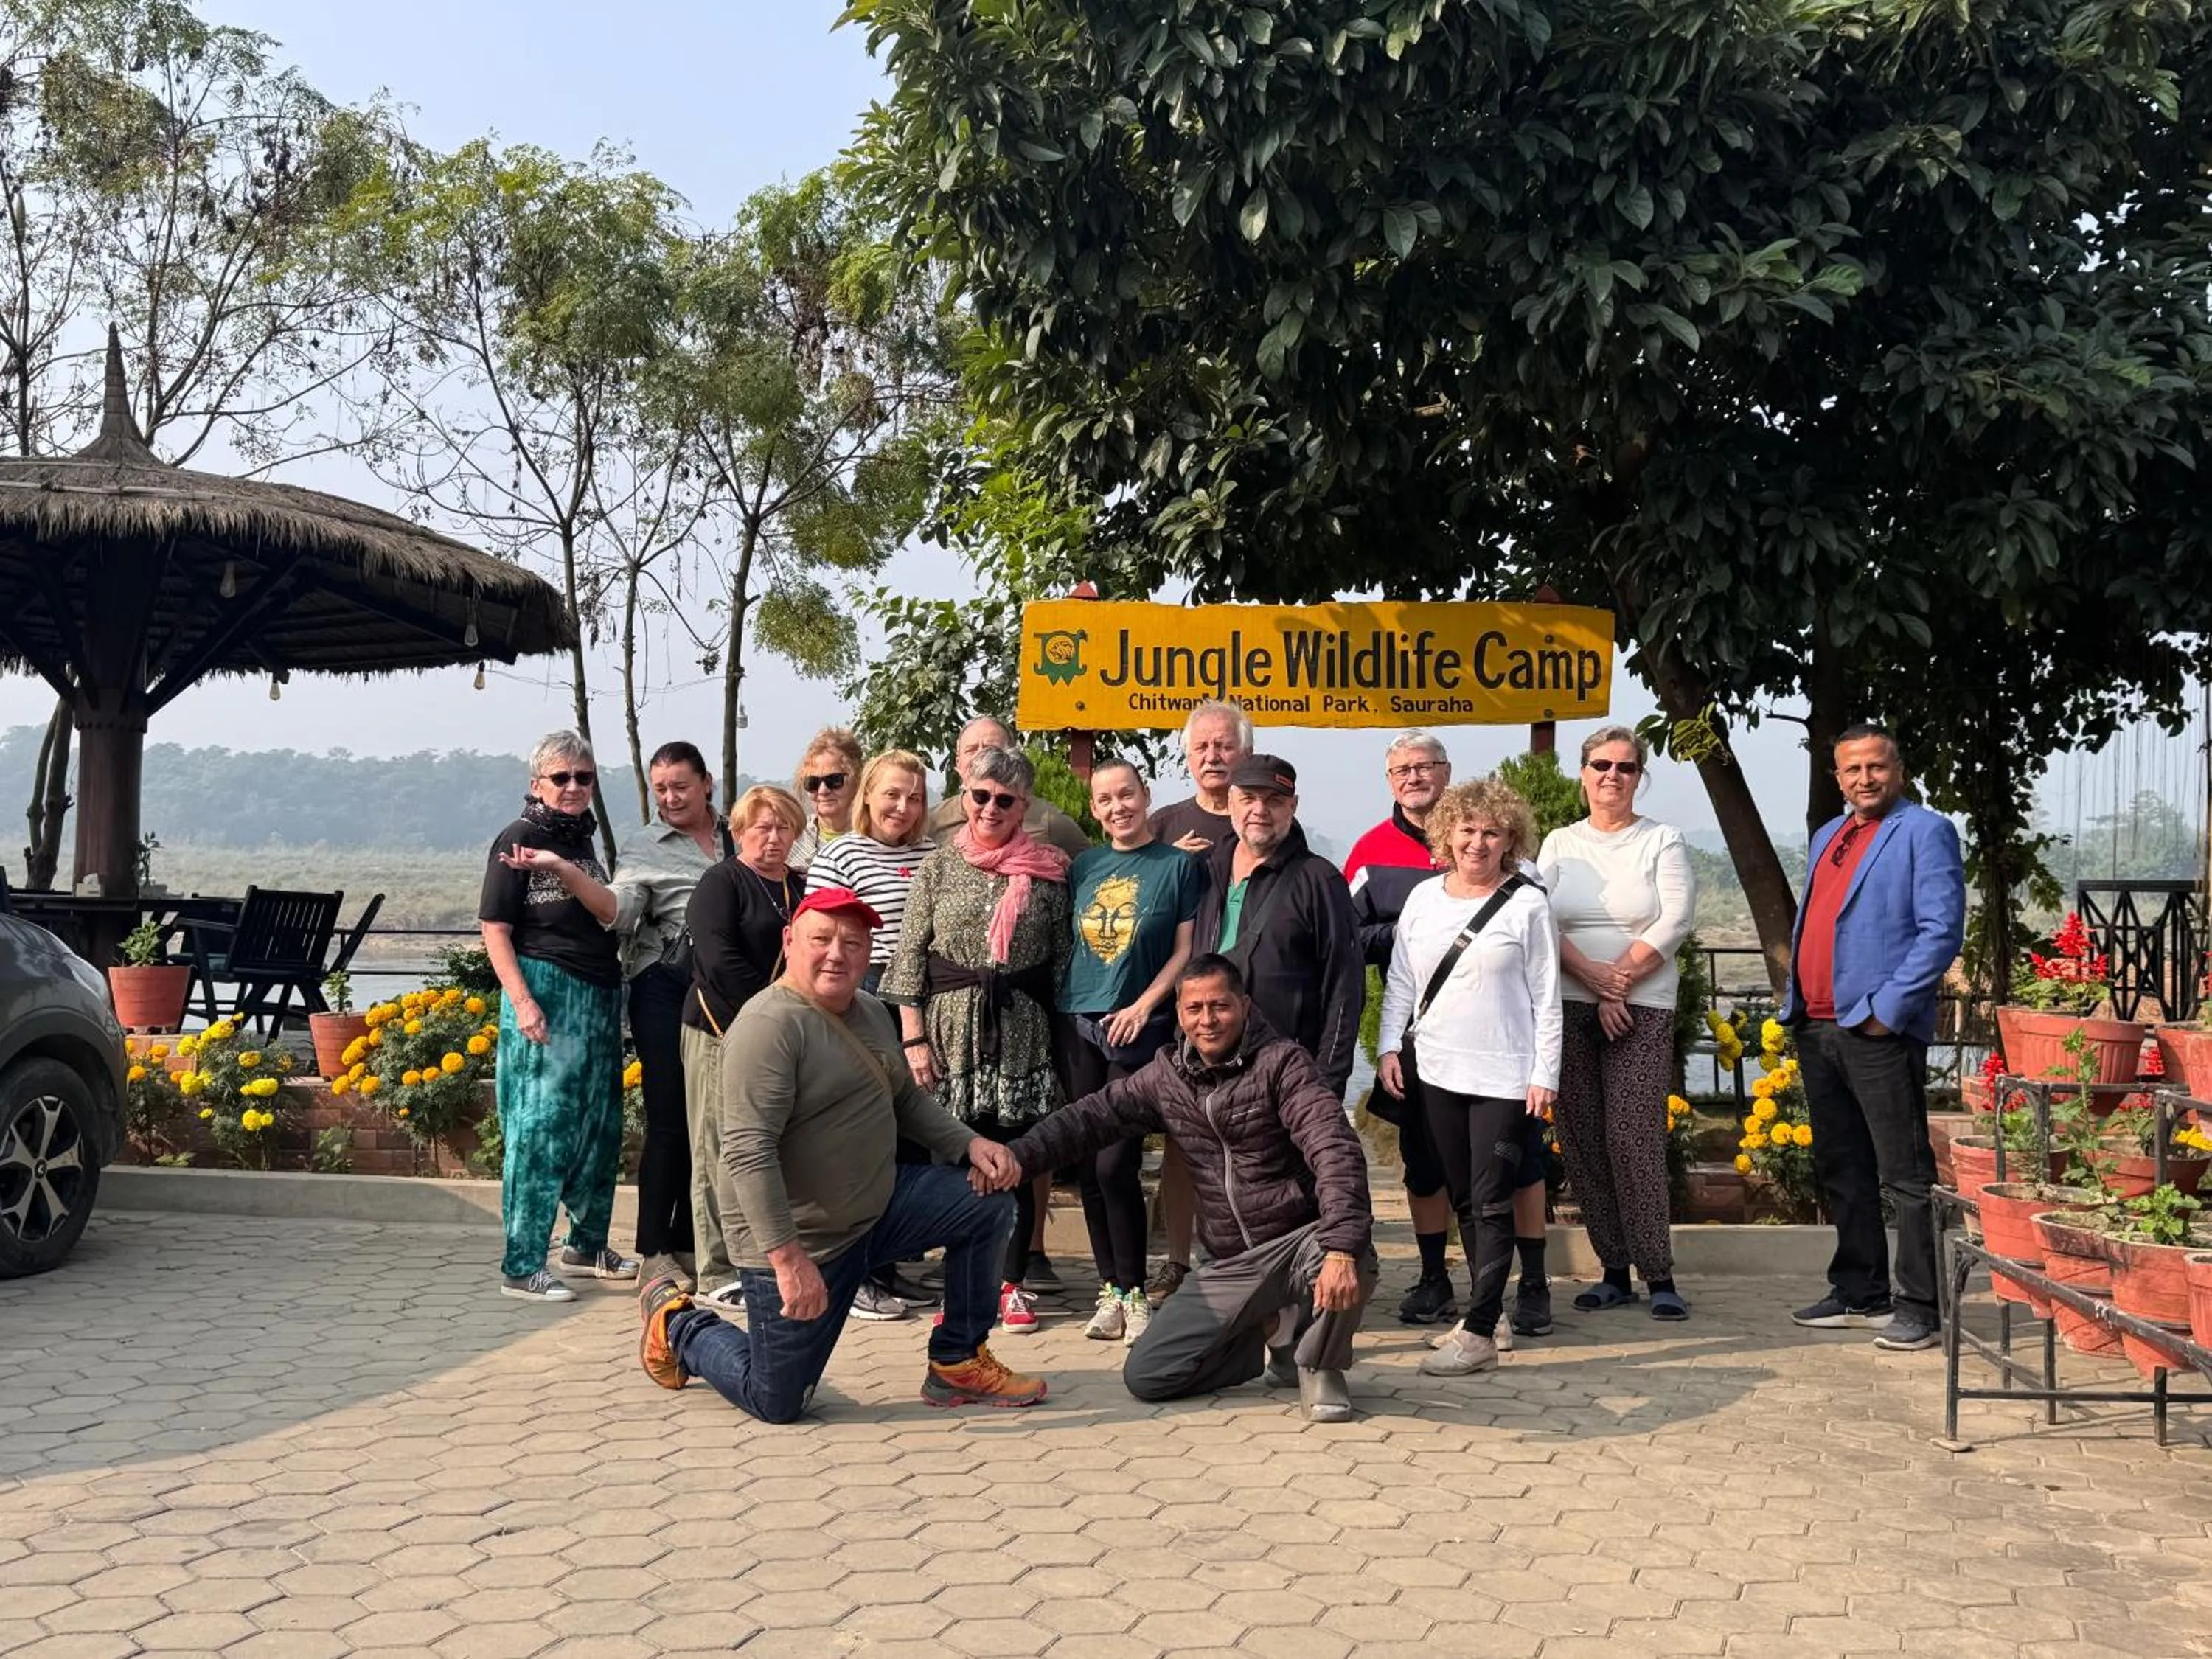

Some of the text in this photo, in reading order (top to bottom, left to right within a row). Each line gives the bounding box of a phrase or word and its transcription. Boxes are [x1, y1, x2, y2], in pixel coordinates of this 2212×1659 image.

[1099, 629, 1602, 703] Jungle Wildlife Camp
[1228, 694, 1310, 712] National
[1391, 695, 1474, 713] Sauraha
